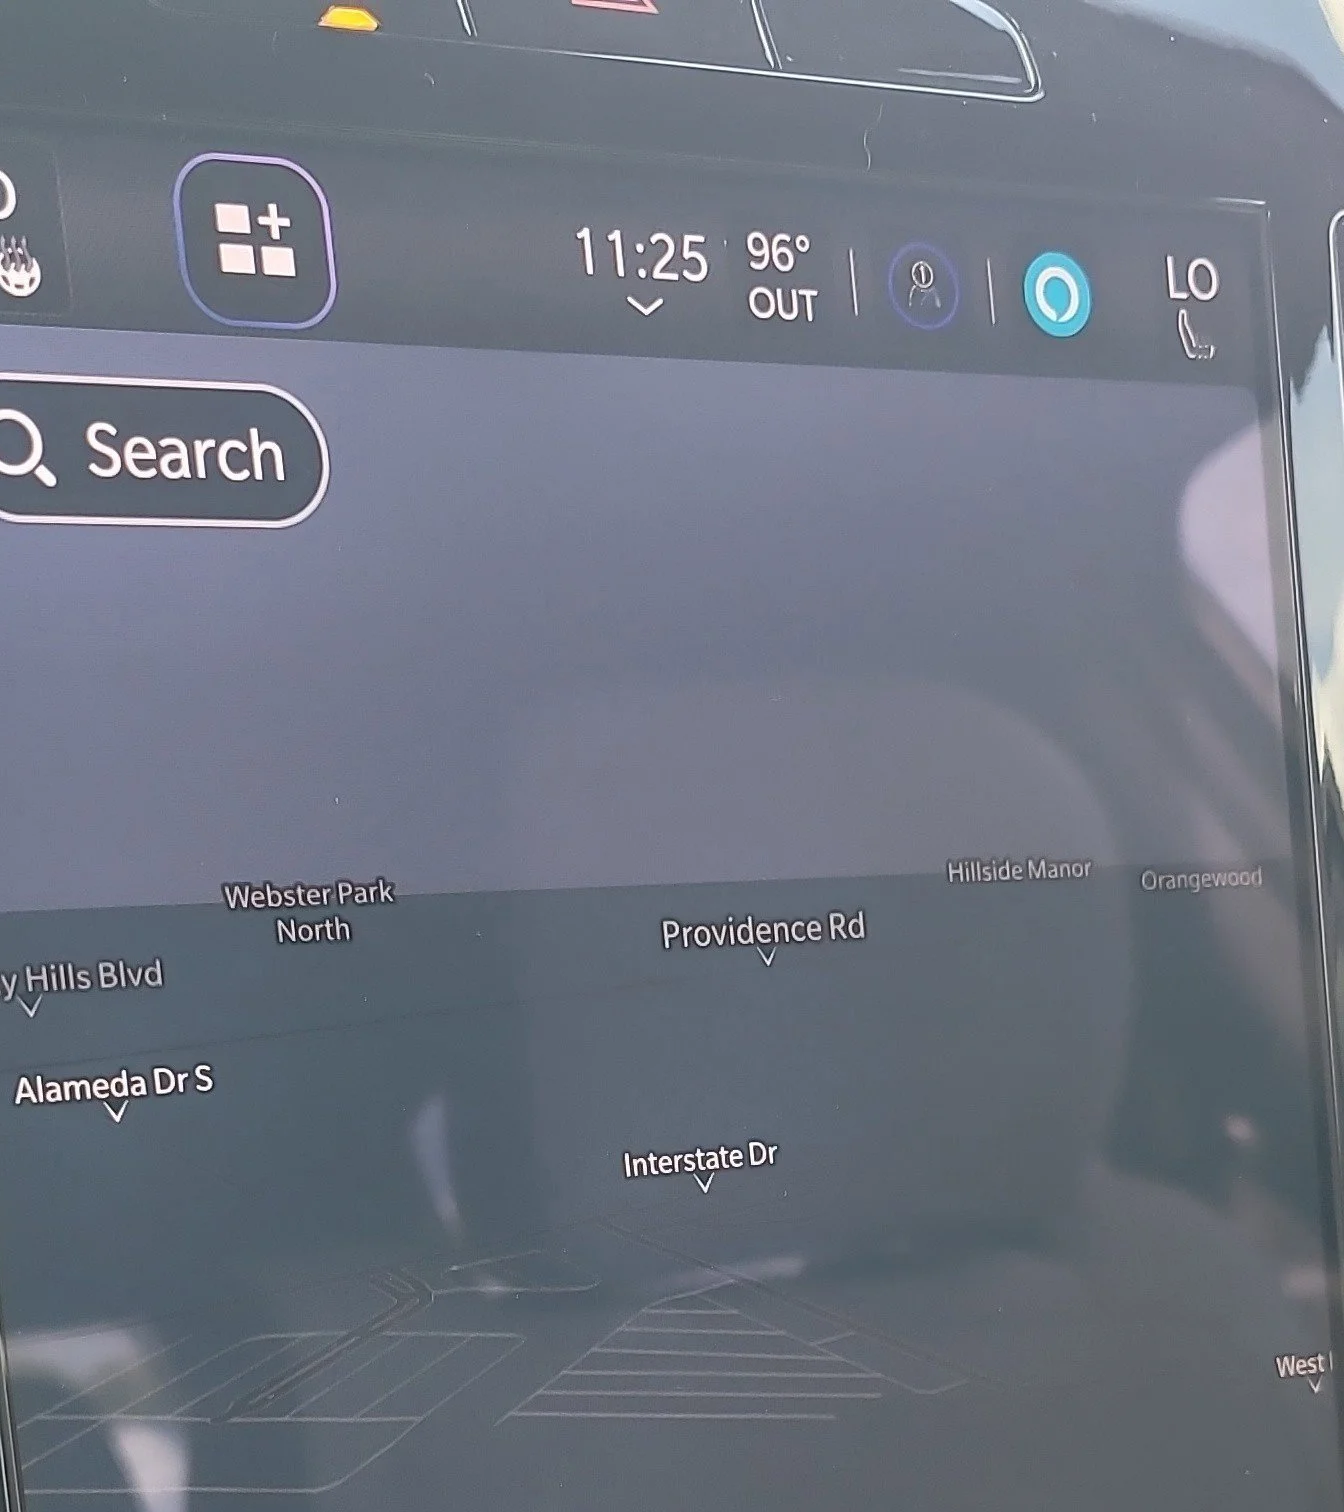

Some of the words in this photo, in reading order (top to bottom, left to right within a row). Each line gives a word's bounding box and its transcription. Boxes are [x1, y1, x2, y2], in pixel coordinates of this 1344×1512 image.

[575, 227, 709, 281] 11:25
[1166, 255, 1219, 301] LO
[748, 287, 818, 322] OUT
[84, 420, 286, 482] Search
[947, 859, 1023, 883] Hillside
[1028, 858, 1092, 879] Manor
[1141, 867, 1263, 893] Orangewood
[224, 882, 332, 909] Webster
[337, 878, 395, 904] Park
[276, 917, 351, 943] North
[662, 915, 823, 949] Providence
[829, 910, 866, 941] Rd
[25, 963, 91, 993] Hills
[99, 958, 163, 988] Blvd
[14, 1069, 147, 1105] Alameda
[153, 1067, 191, 1095] Dr
[194, 1064, 214, 1092] S
[623, 1147, 743, 1178] Interstate
[748, 1141, 778, 1167] Dr
[1276, 1353, 1325, 1378] West
